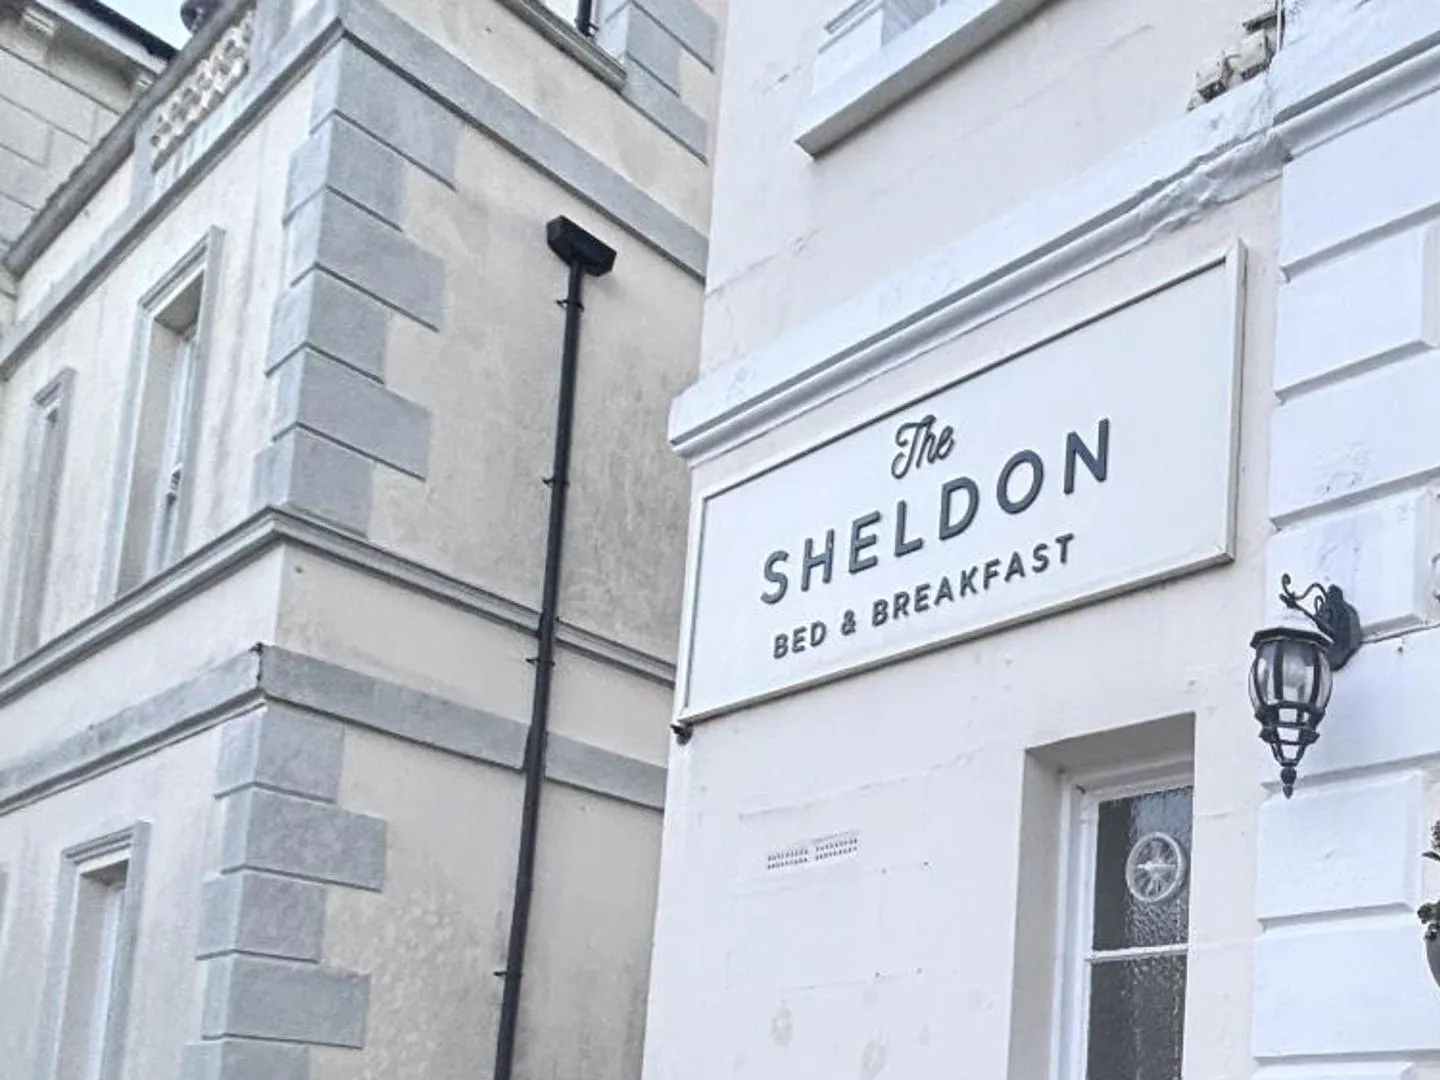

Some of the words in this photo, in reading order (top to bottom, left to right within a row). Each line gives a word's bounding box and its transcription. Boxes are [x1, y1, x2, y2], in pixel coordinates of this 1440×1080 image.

[891, 414, 955, 479] The
[761, 418, 1110, 604] SHELDON
[773, 621, 827, 659] BED
[840, 610, 856, 635] &
[871, 533, 1076, 628] BREAKFAST
